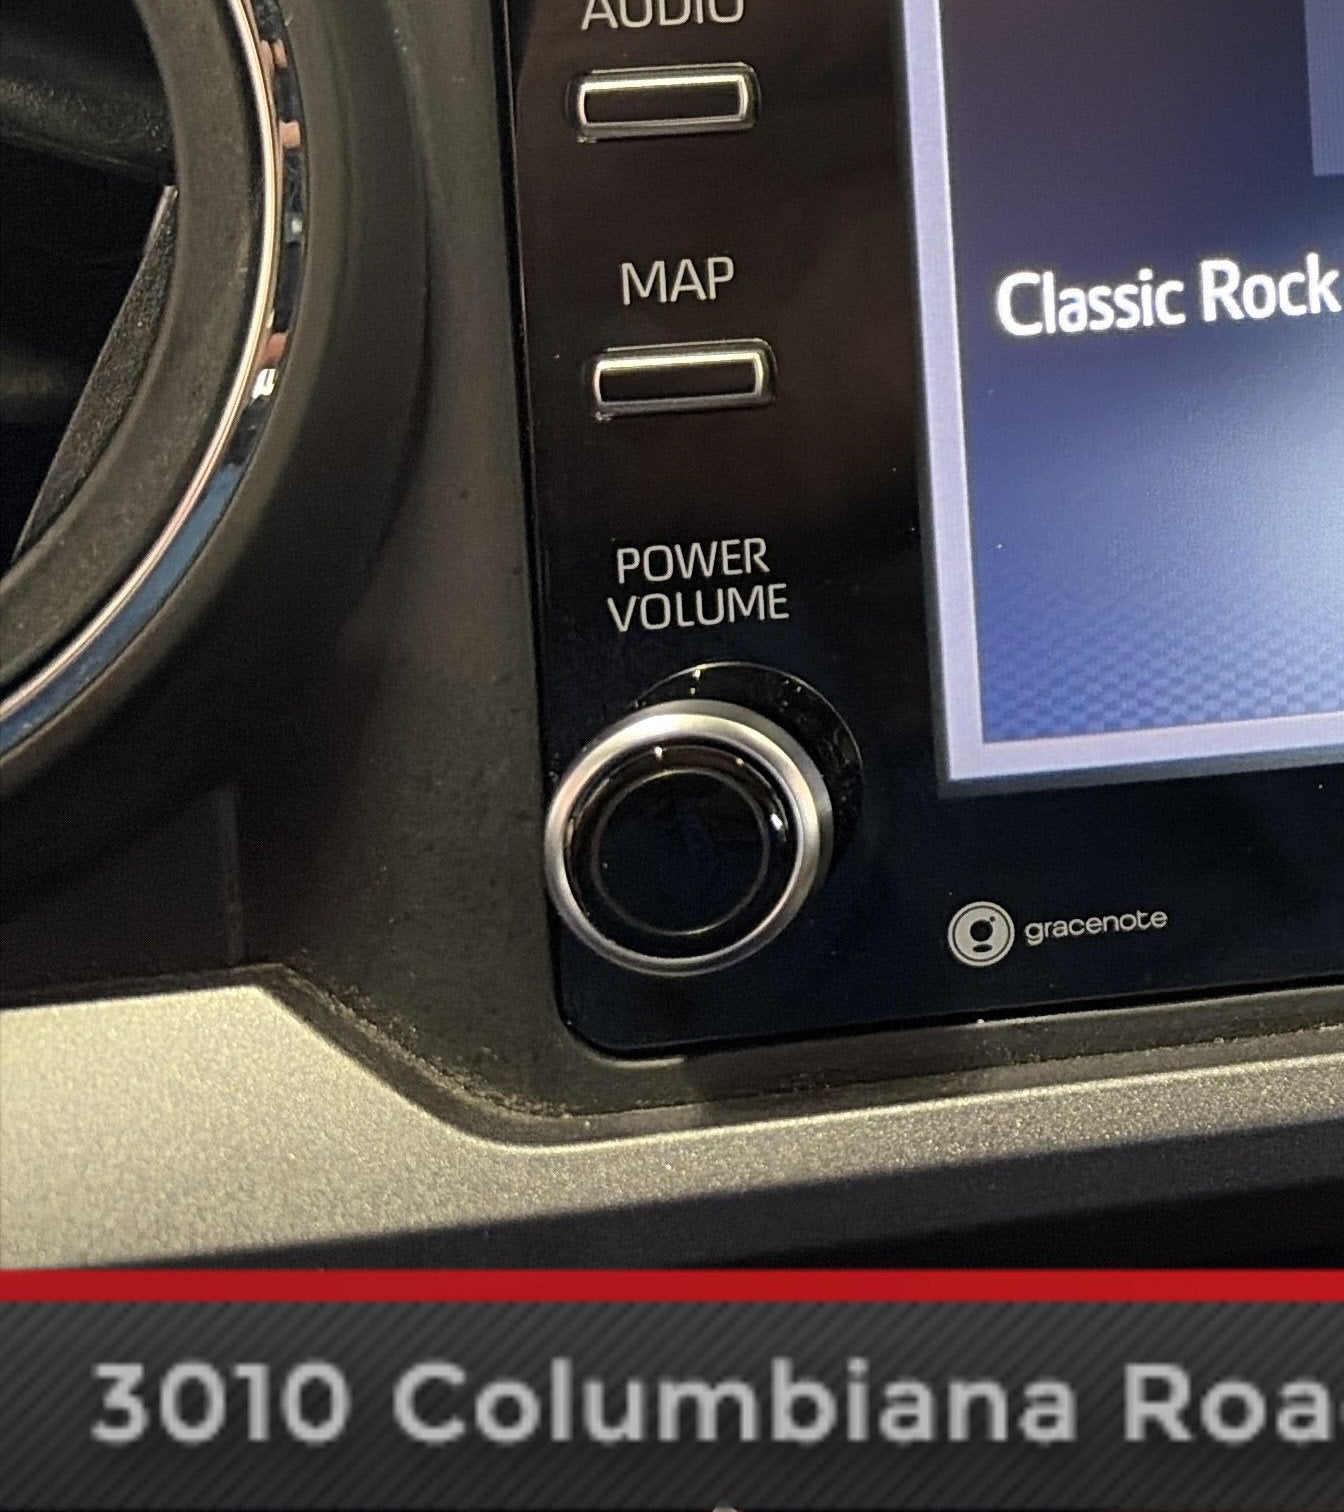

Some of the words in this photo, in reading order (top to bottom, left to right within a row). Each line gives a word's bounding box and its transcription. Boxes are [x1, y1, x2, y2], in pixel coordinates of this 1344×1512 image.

[620, 256, 736, 305] MAP
[995, 269, 1186, 336] Classic
[1200, 254, 1341, 323] Rock
[616, 537, 770, 585] POWER
[607, 584, 790, 633] VOLUME
[1024, 908, 1169, 944] gracenote
